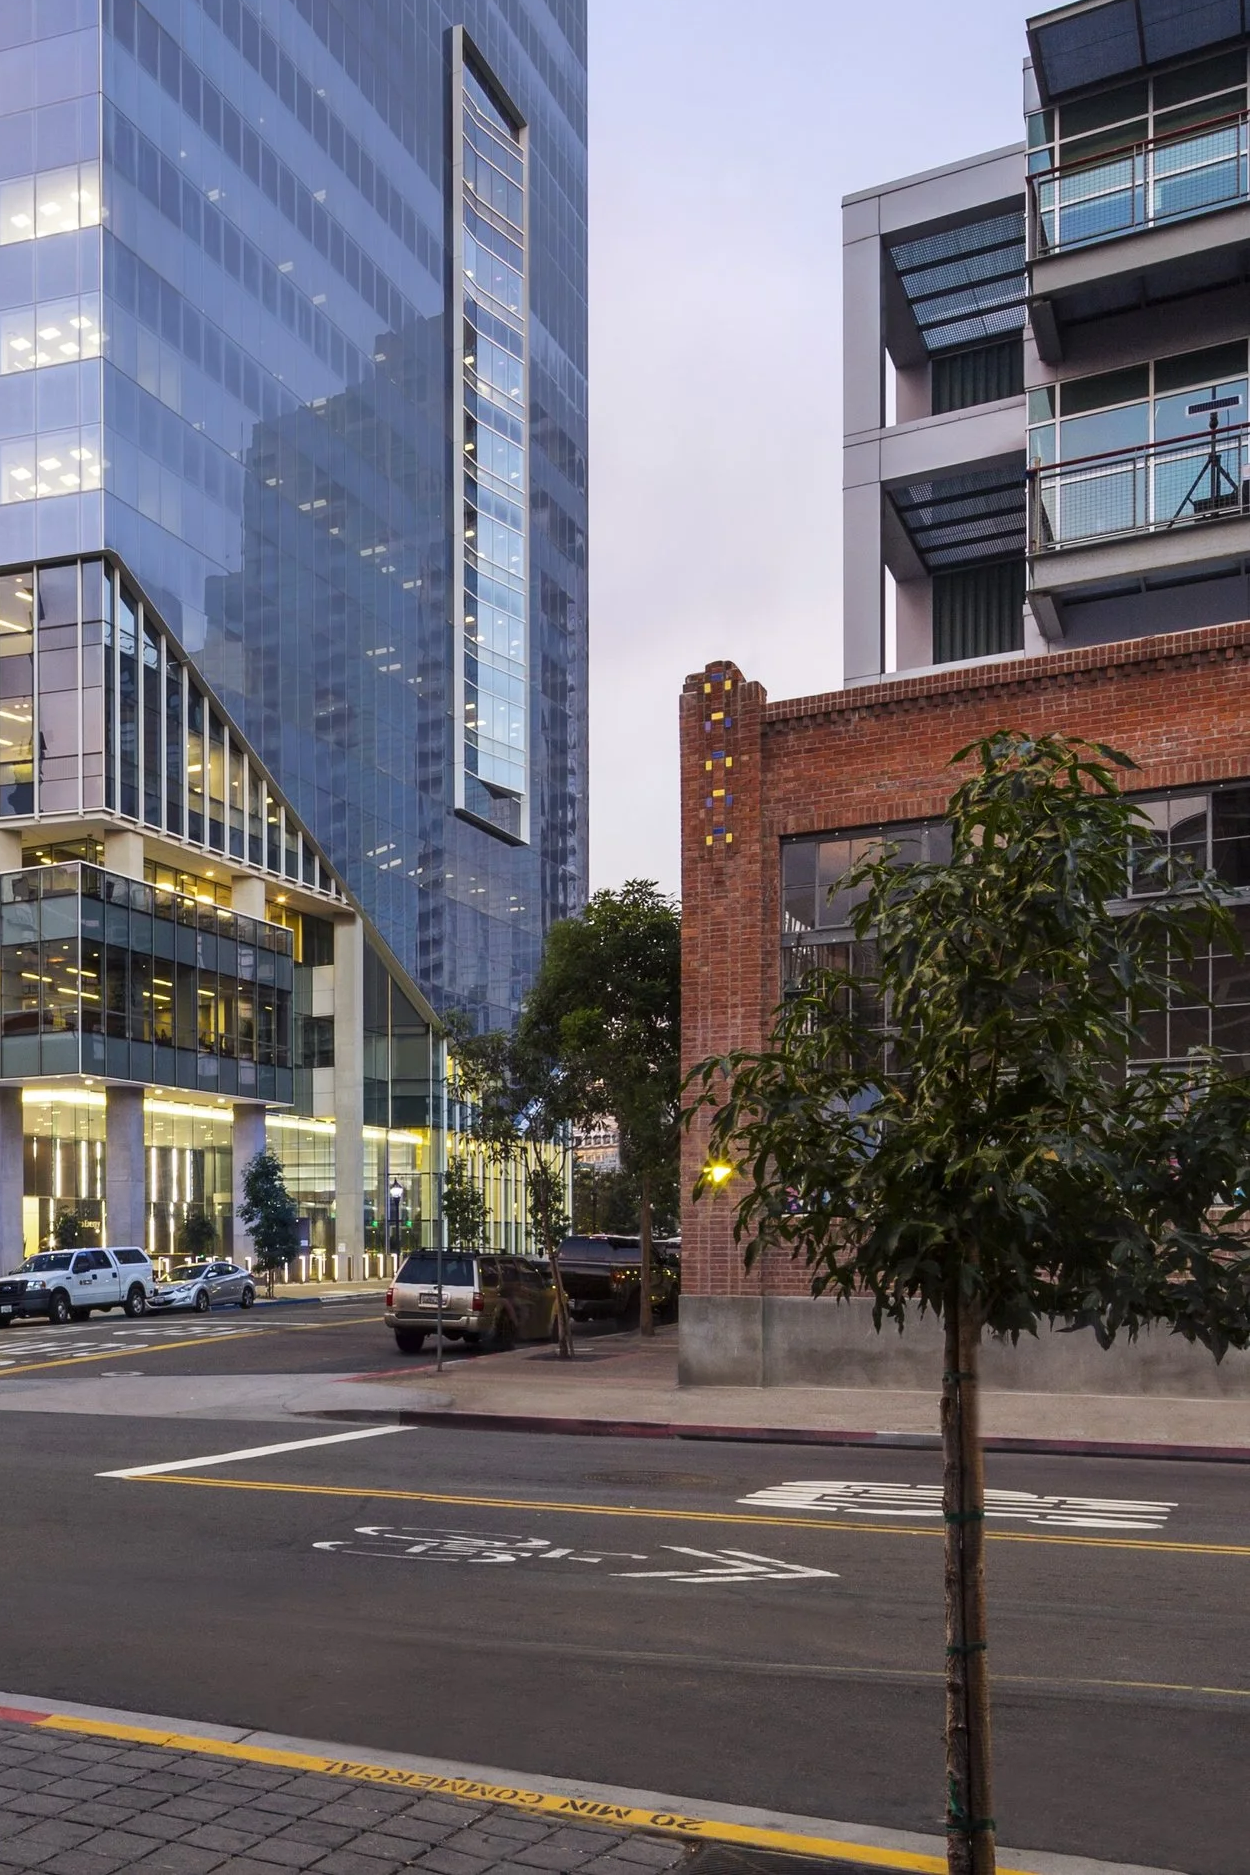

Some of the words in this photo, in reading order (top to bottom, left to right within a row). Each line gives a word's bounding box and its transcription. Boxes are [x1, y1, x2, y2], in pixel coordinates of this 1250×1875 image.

[735, 1479, 1180, 1529] STOP
[322, 1758, 545, 1805] COMMERCIAL
[558, 1798, 633, 1820] MIN
[649, 1812, 707, 1832] 20
